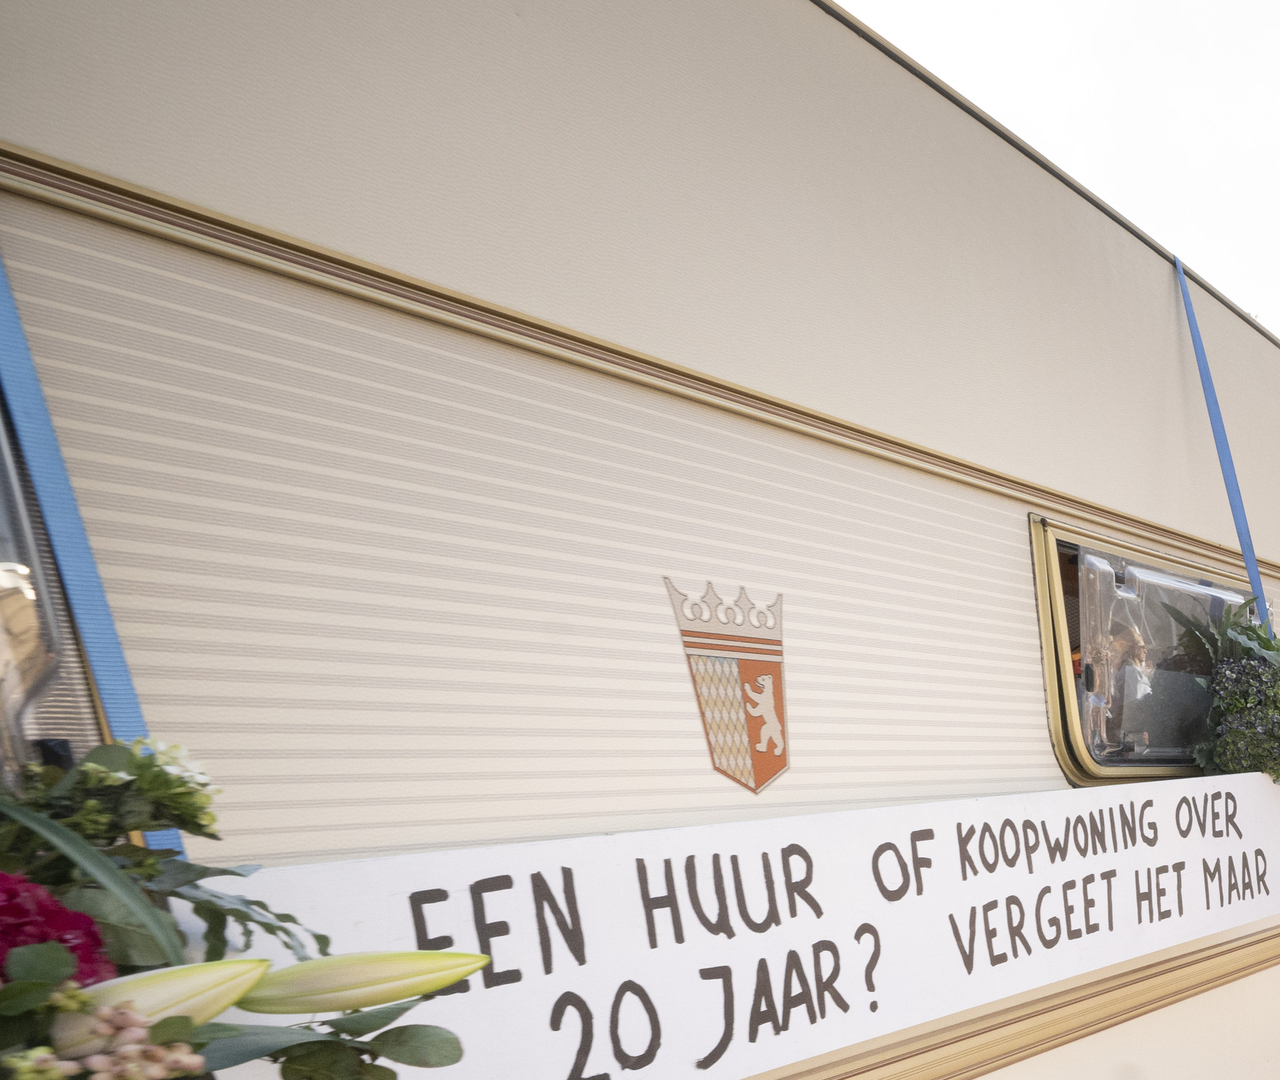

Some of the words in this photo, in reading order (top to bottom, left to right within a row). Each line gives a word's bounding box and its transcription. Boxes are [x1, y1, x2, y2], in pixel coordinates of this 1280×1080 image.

[408, 866, 587, 995] EEN
[635, 841, 824, 950] HUUR
[871, 828, 935, 902] OF
[956, 799, 1158, 881] KOOPWONING
[1175, 790, 1243, 840] OVER
[695, 922, 883, 1070] JAAR?
[948, 867, 1117, 976] VERGEET
[1134, 860, 1186, 925] HET
[1202, 847, 1270, 911] MAAR
